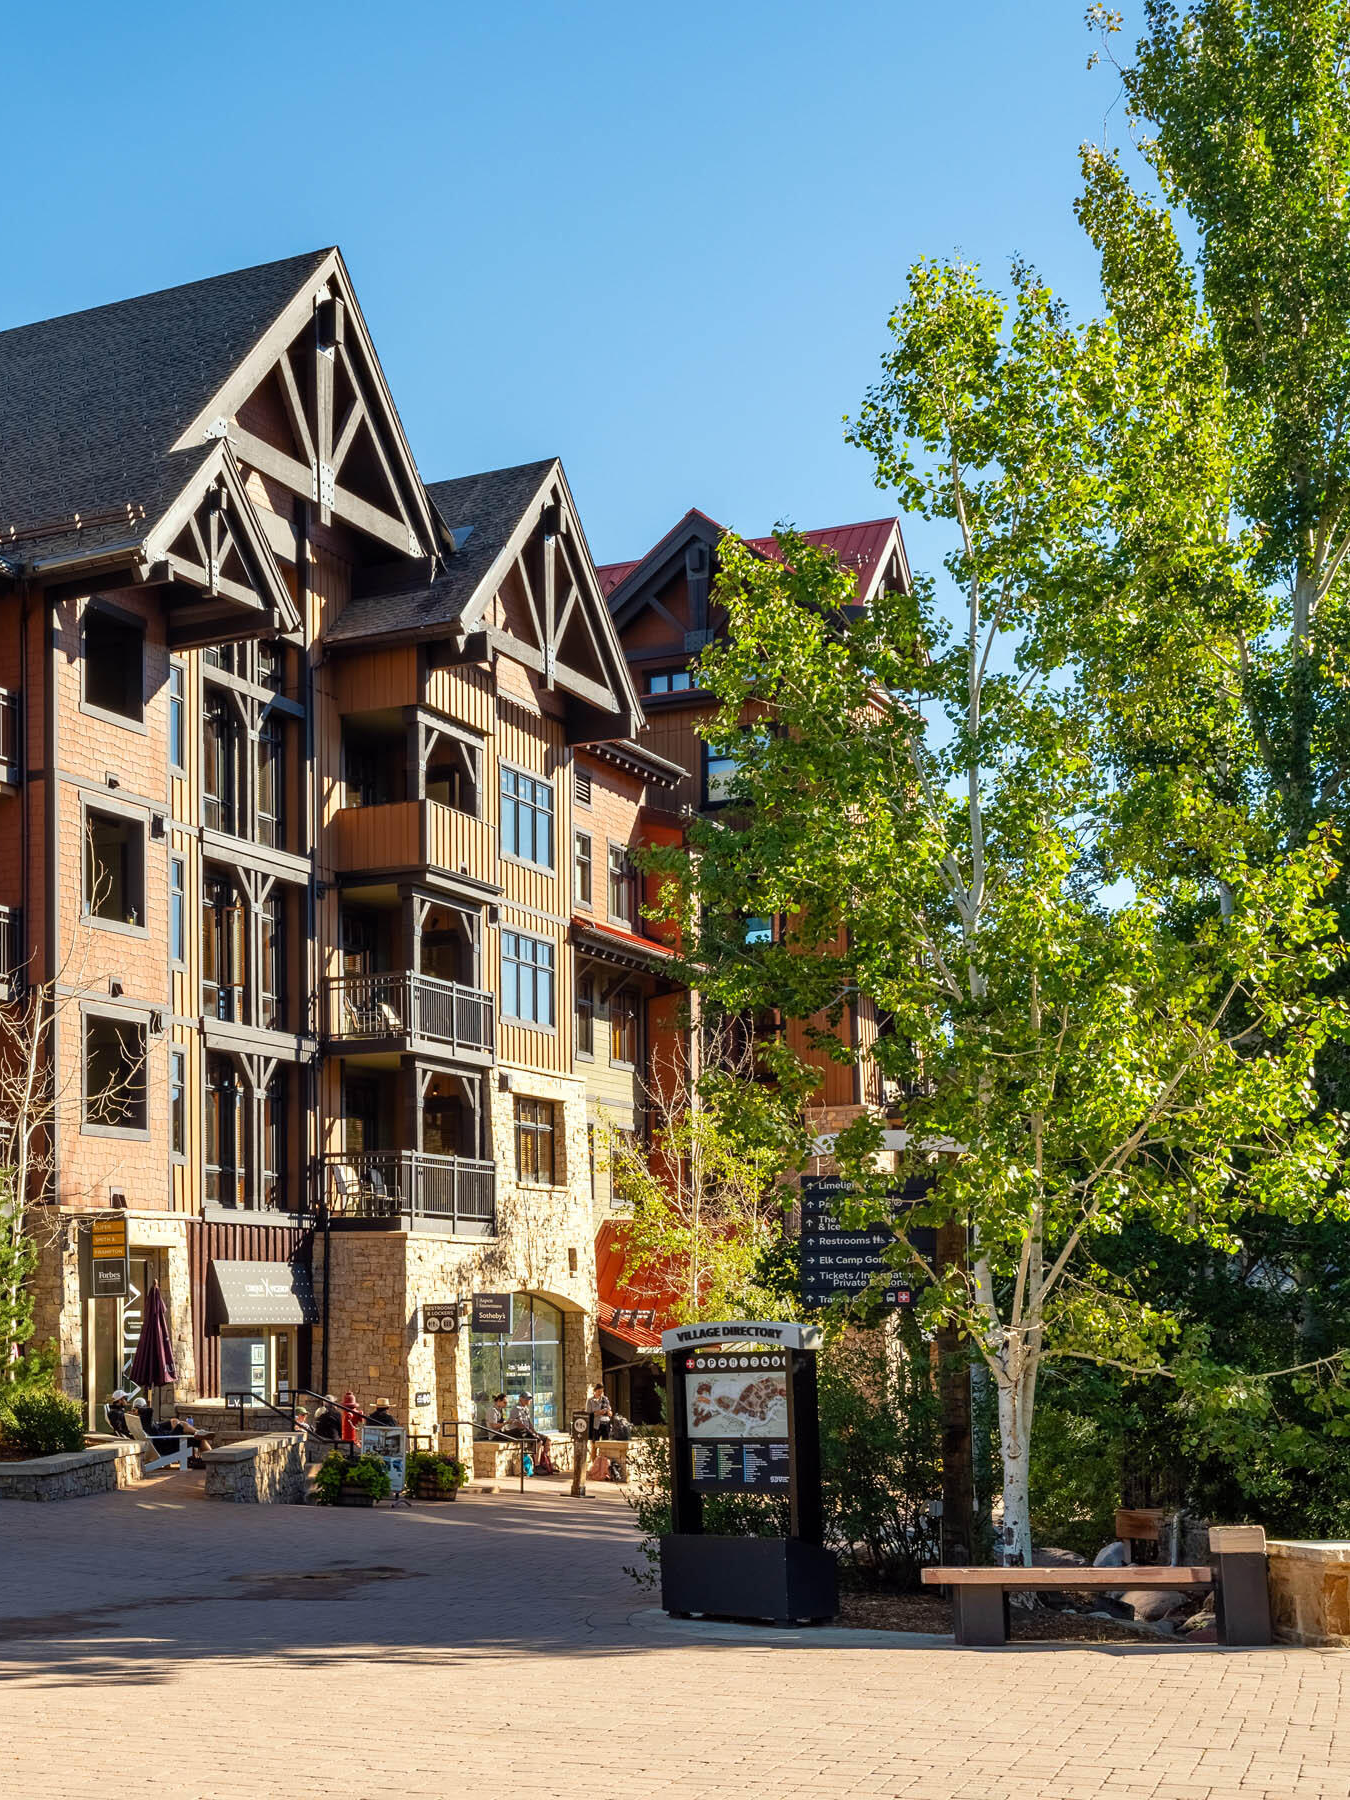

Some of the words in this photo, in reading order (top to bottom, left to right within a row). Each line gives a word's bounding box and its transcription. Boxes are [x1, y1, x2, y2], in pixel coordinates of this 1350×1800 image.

[818, 1181, 861, 1191] Limelig
[818, 1215, 837, 1223] The
[818, 1223, 825, 1231] &
[827, 1223, 841, 1231] Ice
[819, 1237, 871, 1246] Restrooms
[819, 1256, 834, 1264] Elk
[836, 1256, 864, 1267] Camp
[98, 1271, 121, 1279] Forbes
[819, 1271, 854, 1280] Tickets
[833, 1279, 867, 1287] Private
[479, 1312, 506, 1320] Sotheby's
[676, 1326, 721, 1342] VILLAGE
[722, 1326, 783, 1340] DIRECTORY
